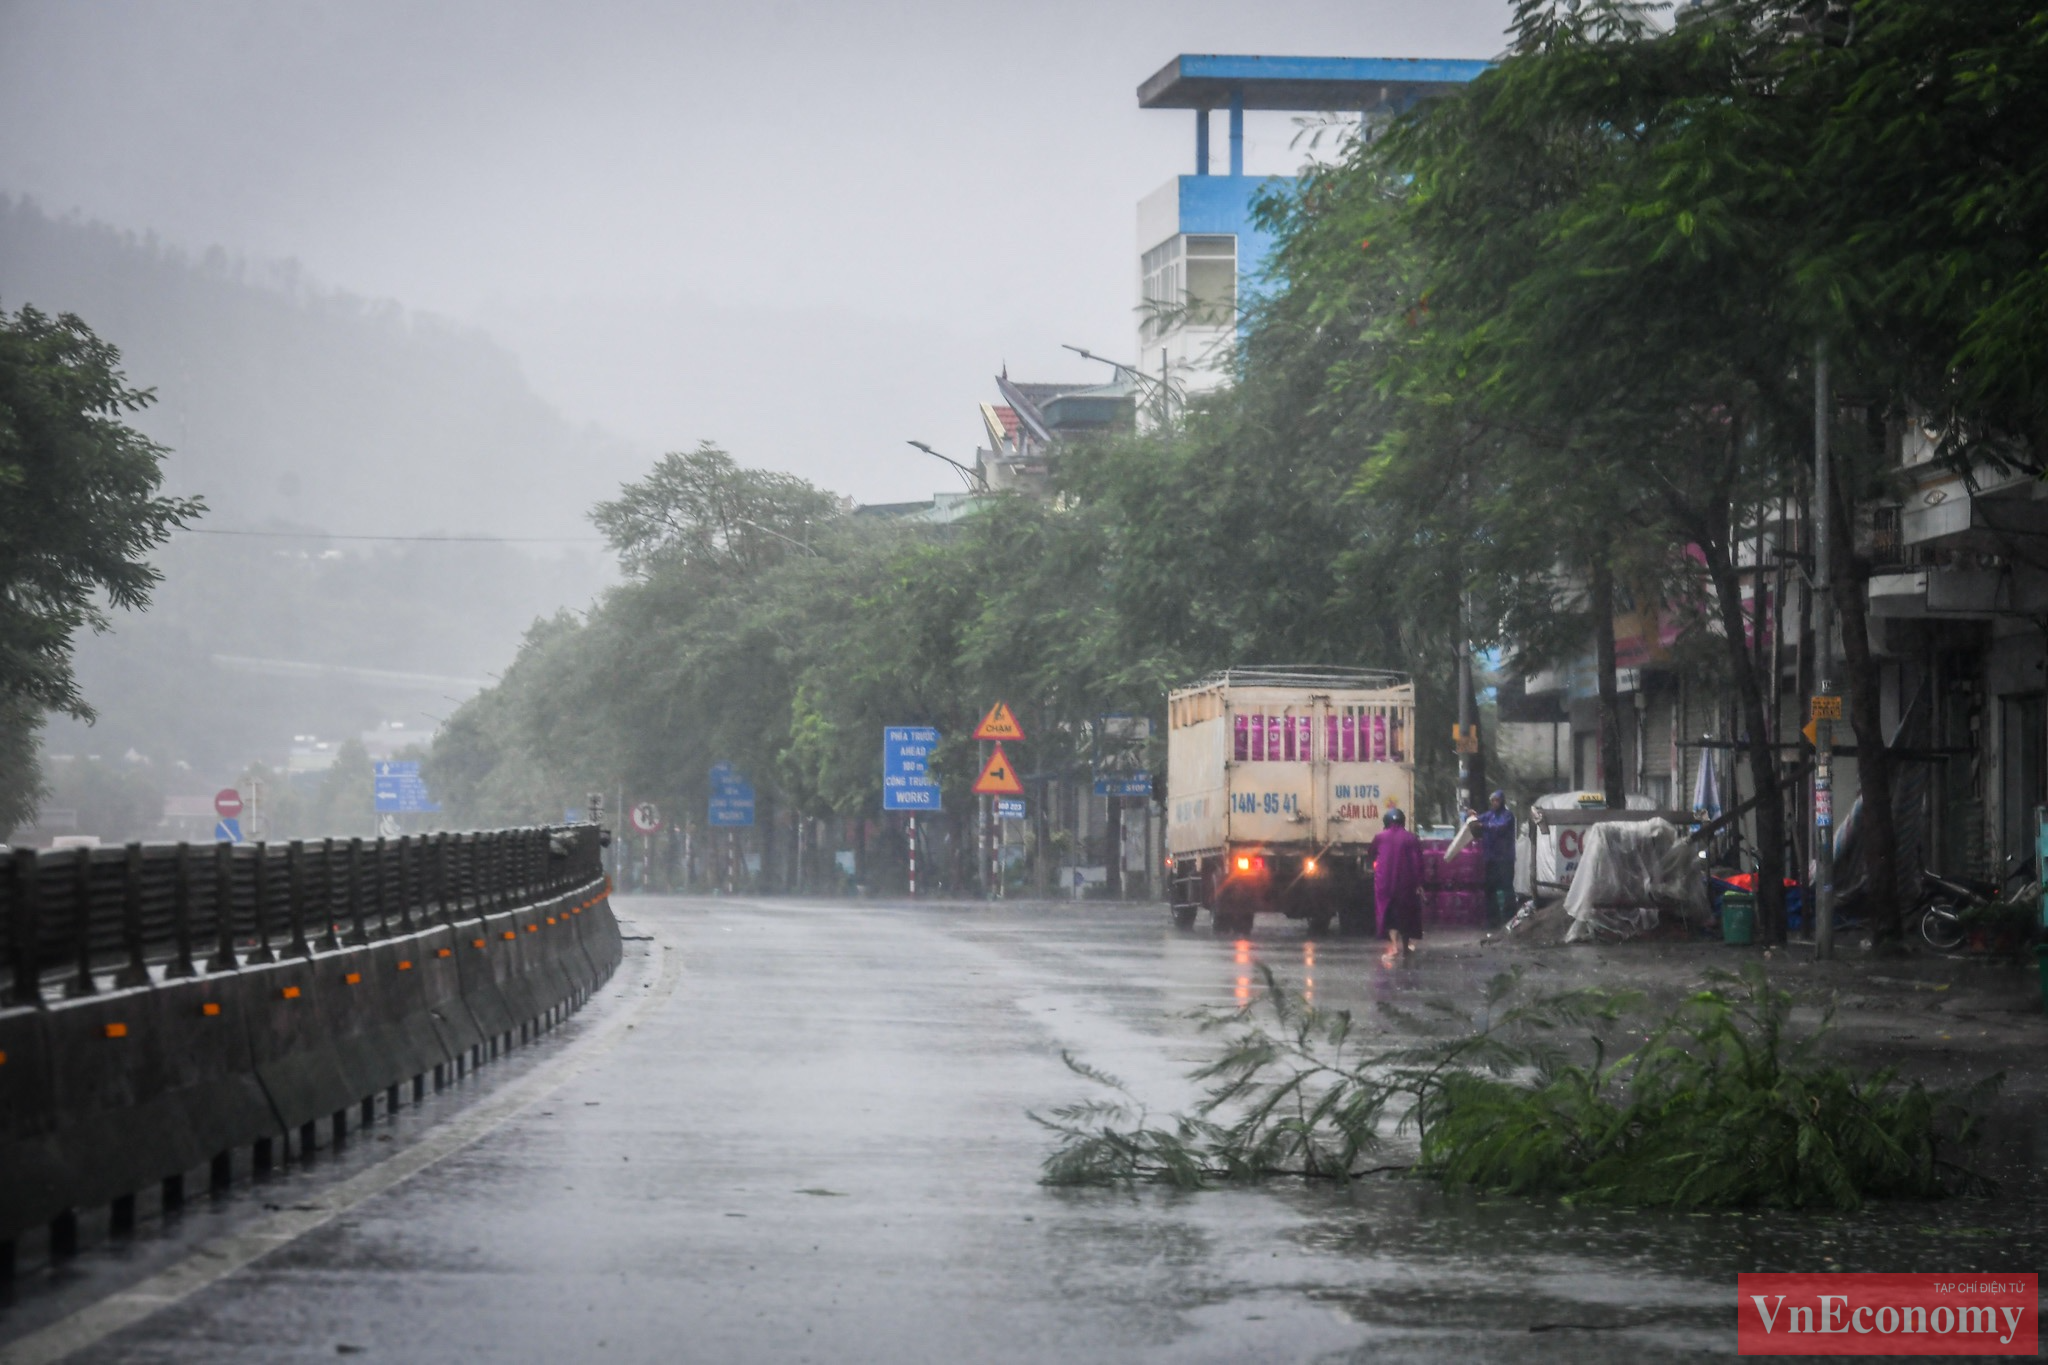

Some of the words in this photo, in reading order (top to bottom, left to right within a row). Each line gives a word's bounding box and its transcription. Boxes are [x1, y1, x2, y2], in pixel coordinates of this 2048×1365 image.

[900, 746, 926, 757] AHEAD
[902, 761, 915, 771] 100
[916, 763, 924, 771] m
[896, 791, 930, 804] WORKS
[1335, 785, 1351, 798] UN
[1354, 785, 1380, 798] 1075
